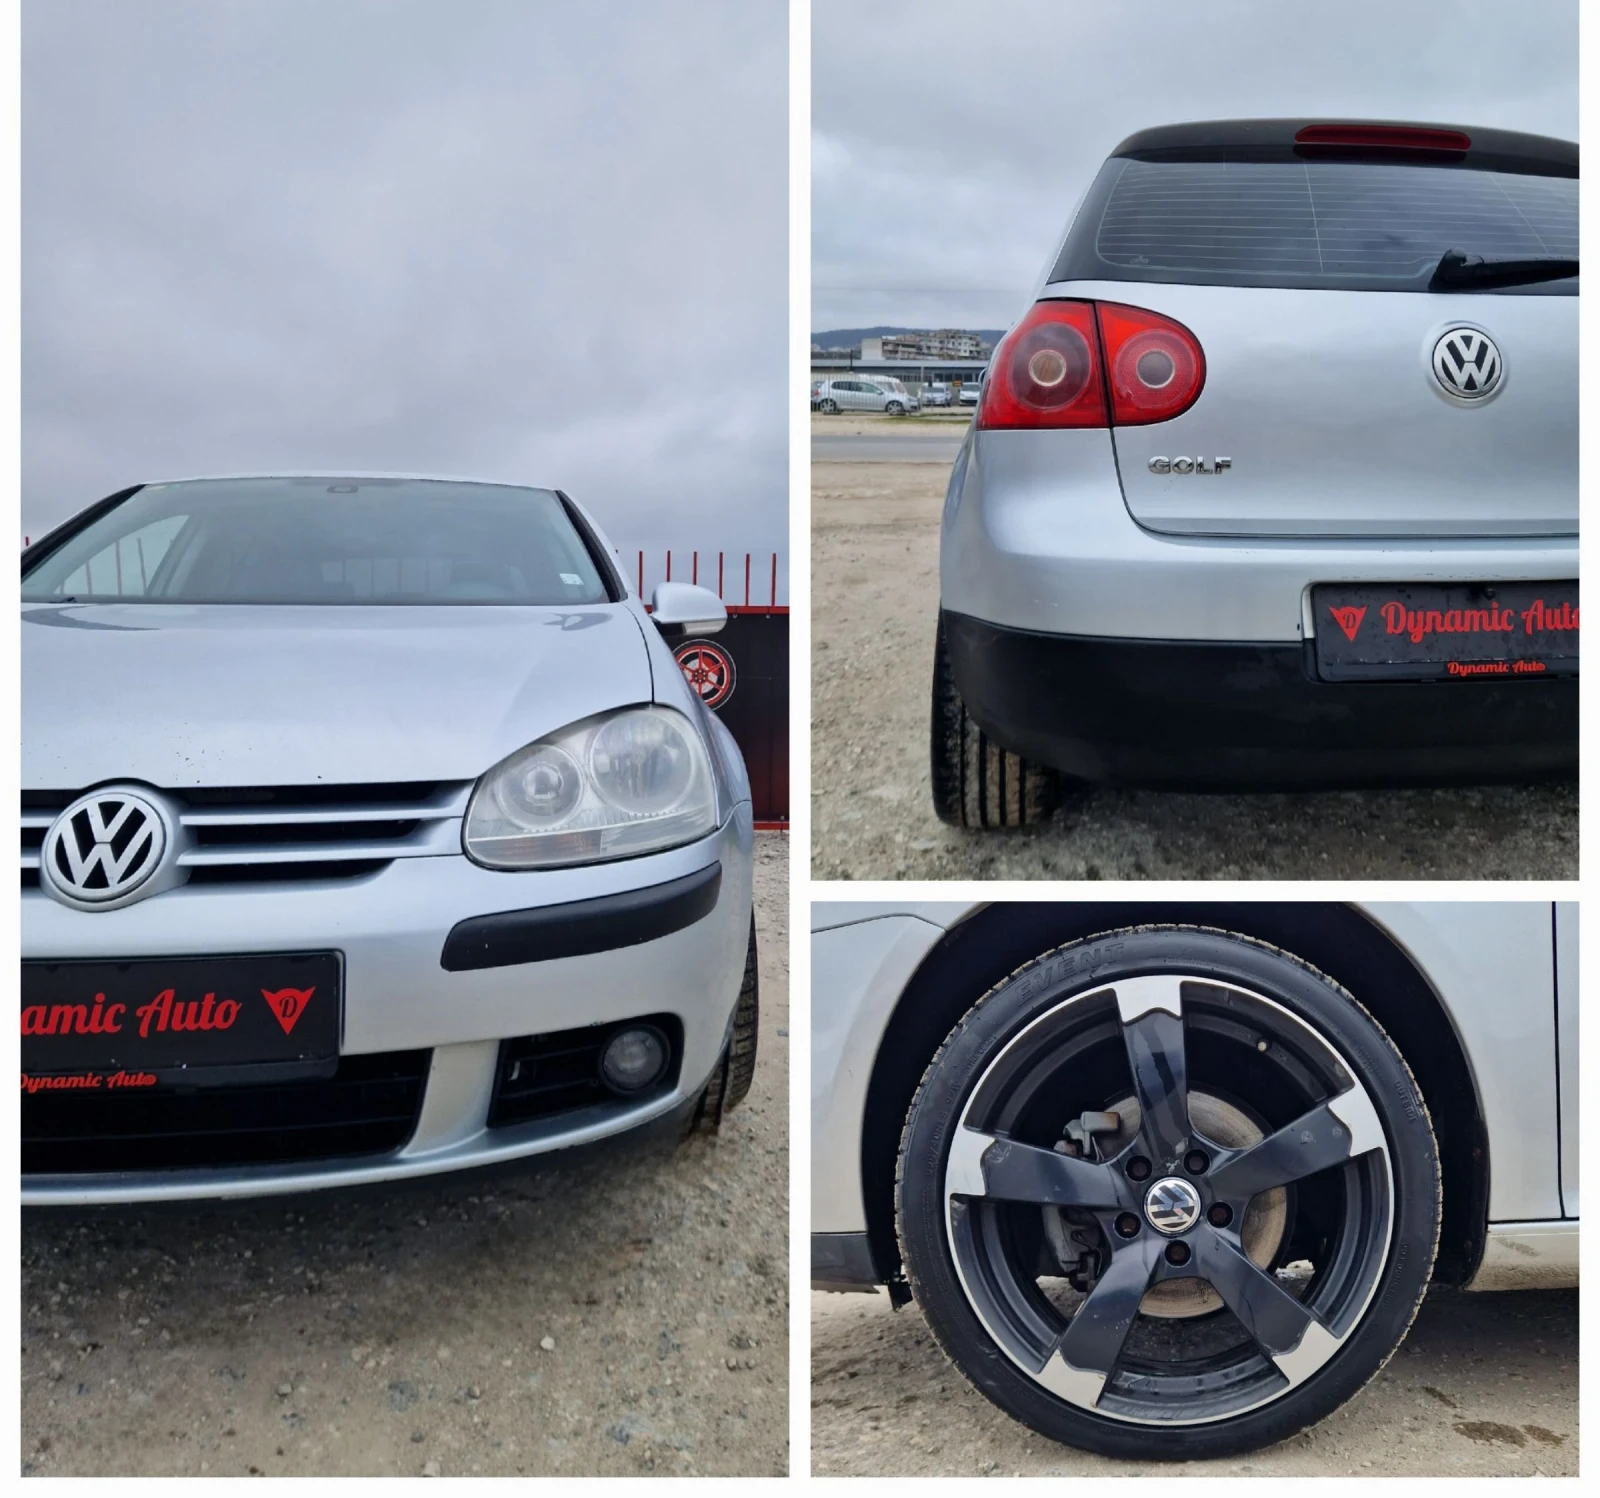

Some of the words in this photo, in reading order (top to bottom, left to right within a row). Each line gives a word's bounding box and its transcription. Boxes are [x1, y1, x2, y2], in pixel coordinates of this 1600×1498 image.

[1147, 455, 1233, 475] GOLF
[1380, 601, 1514, 643] Dynamic
[1447, 661, 1509, 677] Dynamic
[1512, 660, 1546, 673] Auto
[1013, 943, 1125, 1007] EVENT
[135, 988, 242, 1038] Auto
[107, 1070, 157, 1089] Auto
